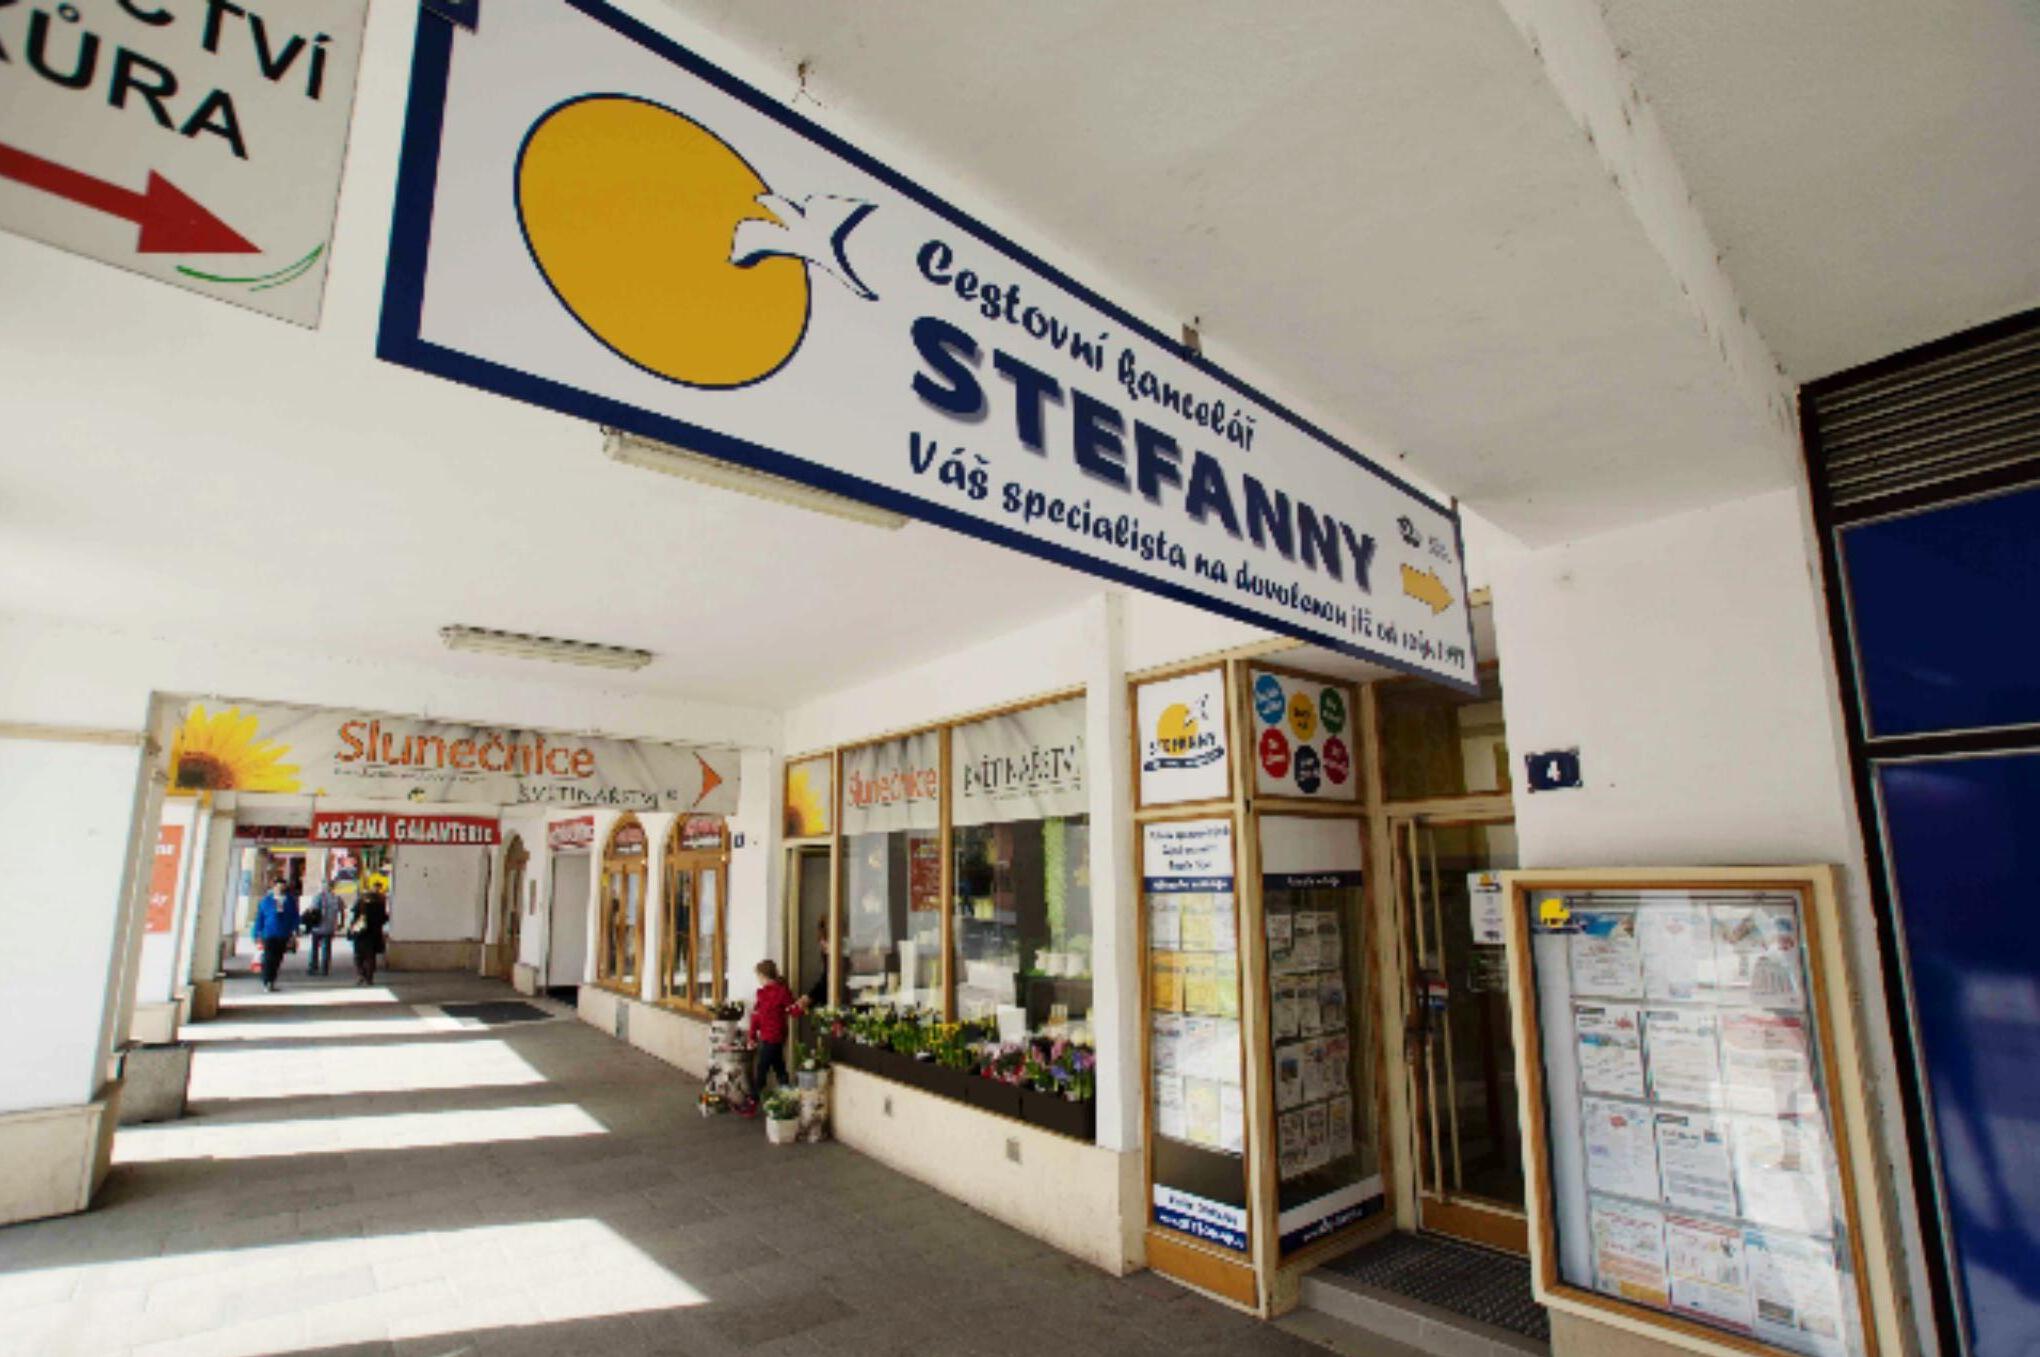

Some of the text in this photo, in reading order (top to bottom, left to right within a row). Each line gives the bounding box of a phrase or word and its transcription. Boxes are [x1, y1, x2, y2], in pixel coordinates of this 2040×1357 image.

[917, 239, 1257, 452] Cestovní kancelář
[910, 316, 1376, 591] STEFANNY
[909, 431, 989, 500] Váš
[1002, 481, 1187, 570] specialista
[1194, 552, 1228, 584] na
[1235, 560, 1347, 628] dovolenou
[335, 719, 595, 779] Slunečnice
[1545, 760, 1562, 782] 4
[317, 815, 493, 843] KOŽENÁ GALANTERIE
